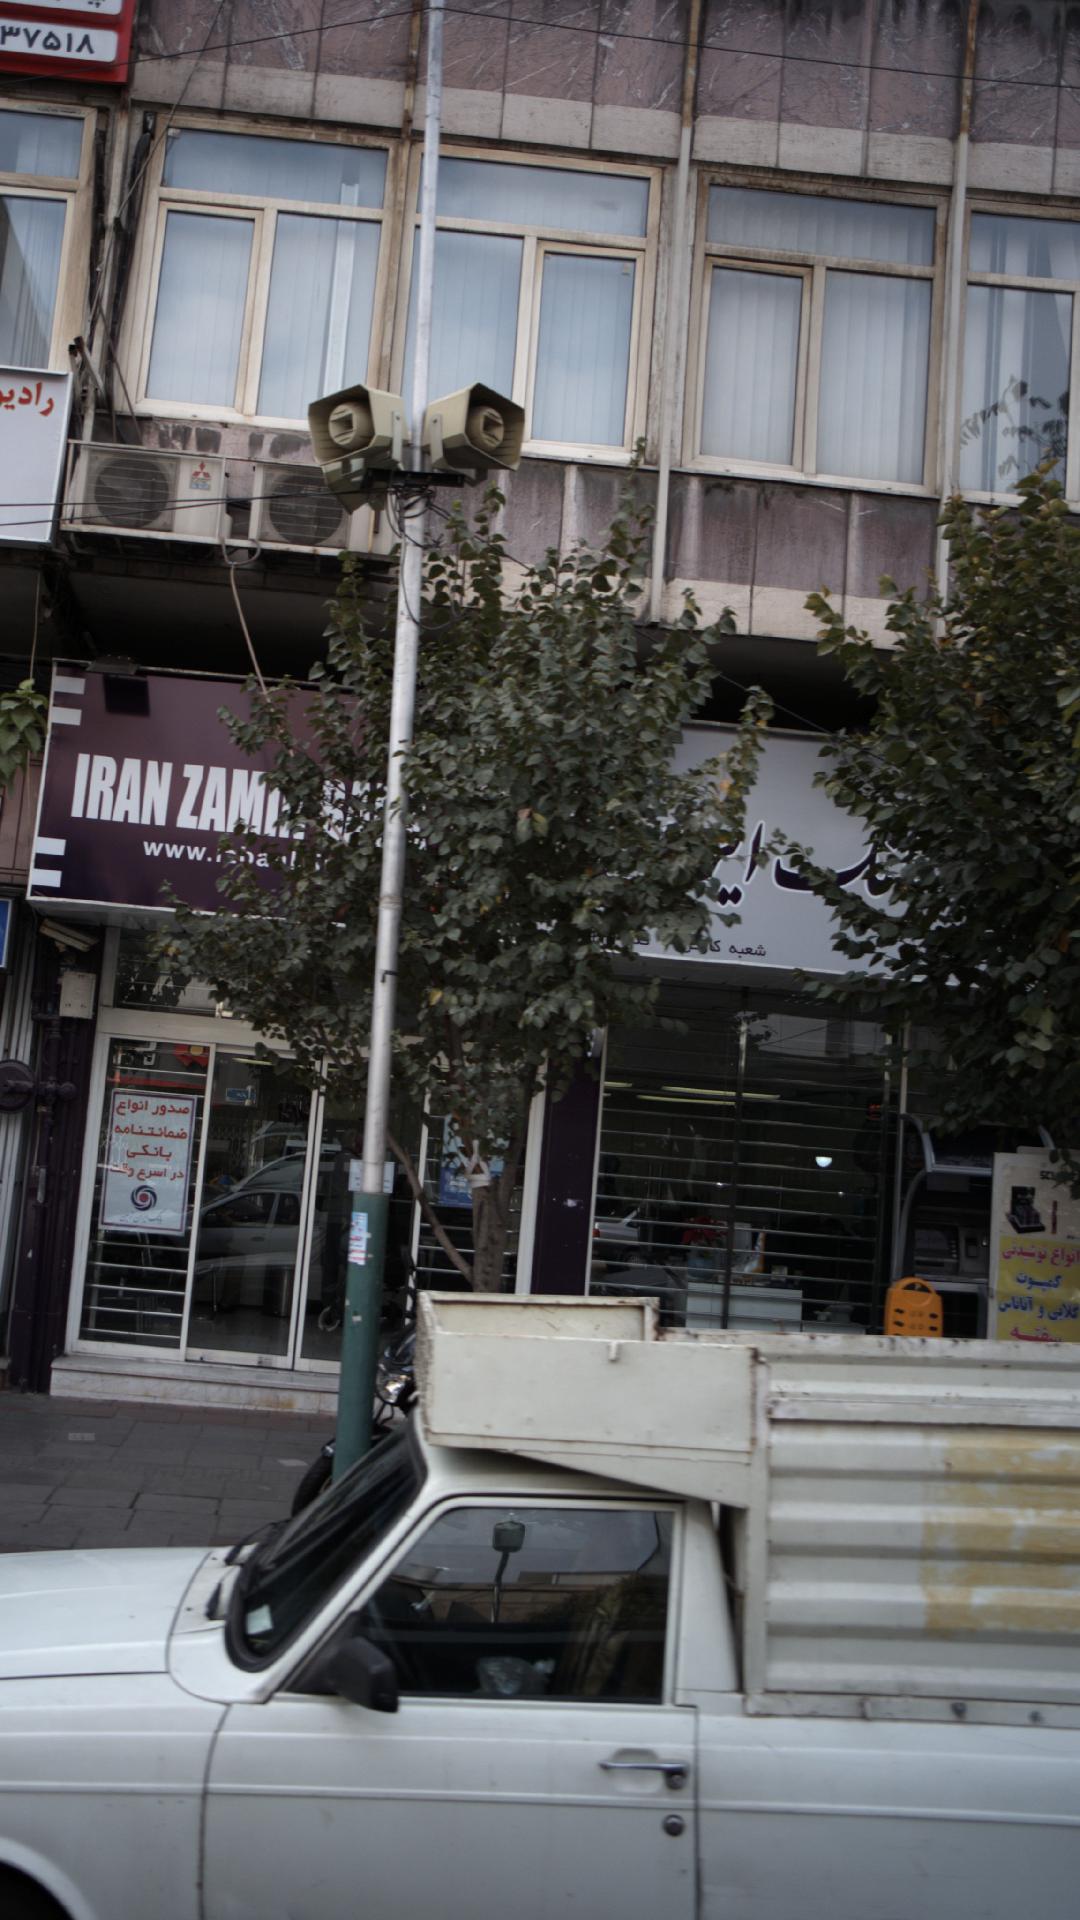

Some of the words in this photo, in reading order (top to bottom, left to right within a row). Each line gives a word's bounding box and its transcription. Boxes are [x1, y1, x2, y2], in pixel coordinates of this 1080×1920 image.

[0, 382, 54, 416] رادی
[71, 753, 173, 826] IRAN
[728, 943, 767, 958] شعبه
[116, 1099, 148, 1116] انواع
[152, 1104, 190, 1116] صدور
[115, 1124, 188, 1140] ضمانتنامه
[126, 1145, 172, 1162] بانکی
[137, 1167, 166, 1181] اسرع
[170, 1171, 185, 1180] در
[1050, 1248, 1080, 1267] انواع
[1036, 1305, 1044, 1319] و
